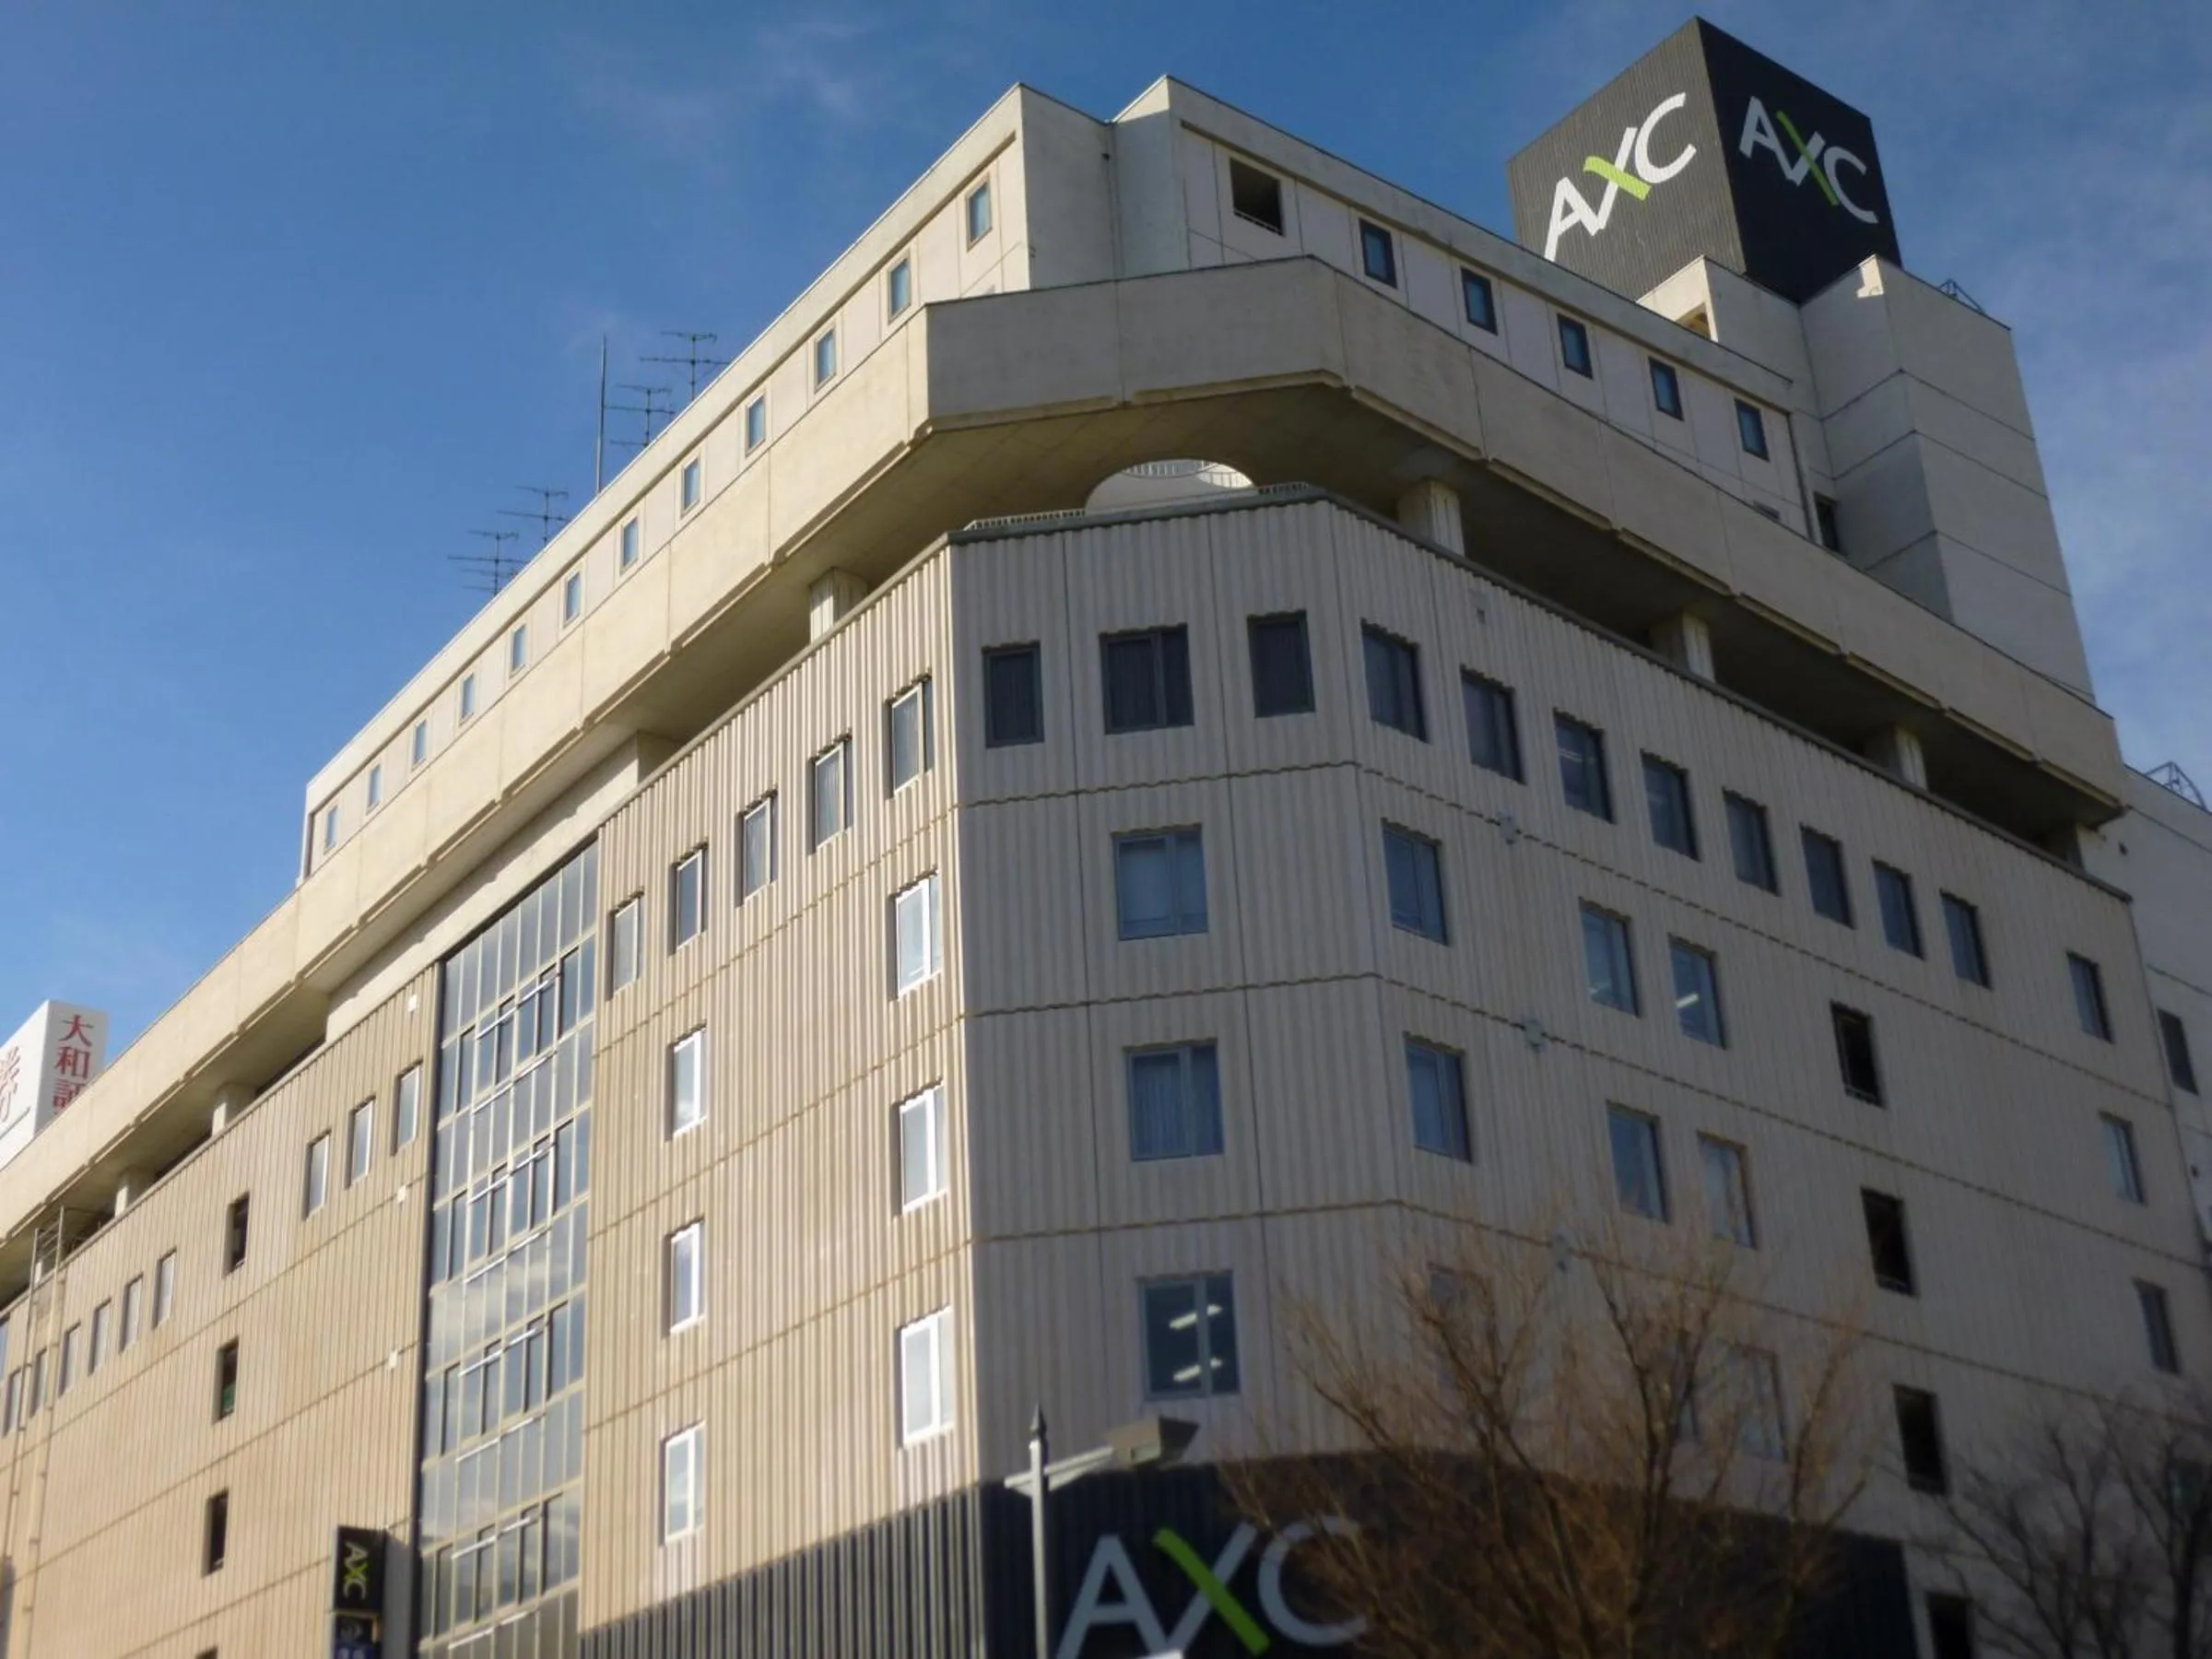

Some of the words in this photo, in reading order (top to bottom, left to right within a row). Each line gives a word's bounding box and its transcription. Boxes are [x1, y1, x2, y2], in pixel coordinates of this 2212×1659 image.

[1544, 92, 1697, 262] AXC
[1739, 96, 1878, 224] AXC
[343, 1541, 369, 1599] AXC
[1056, 1516, 1371, 1659] AXC
